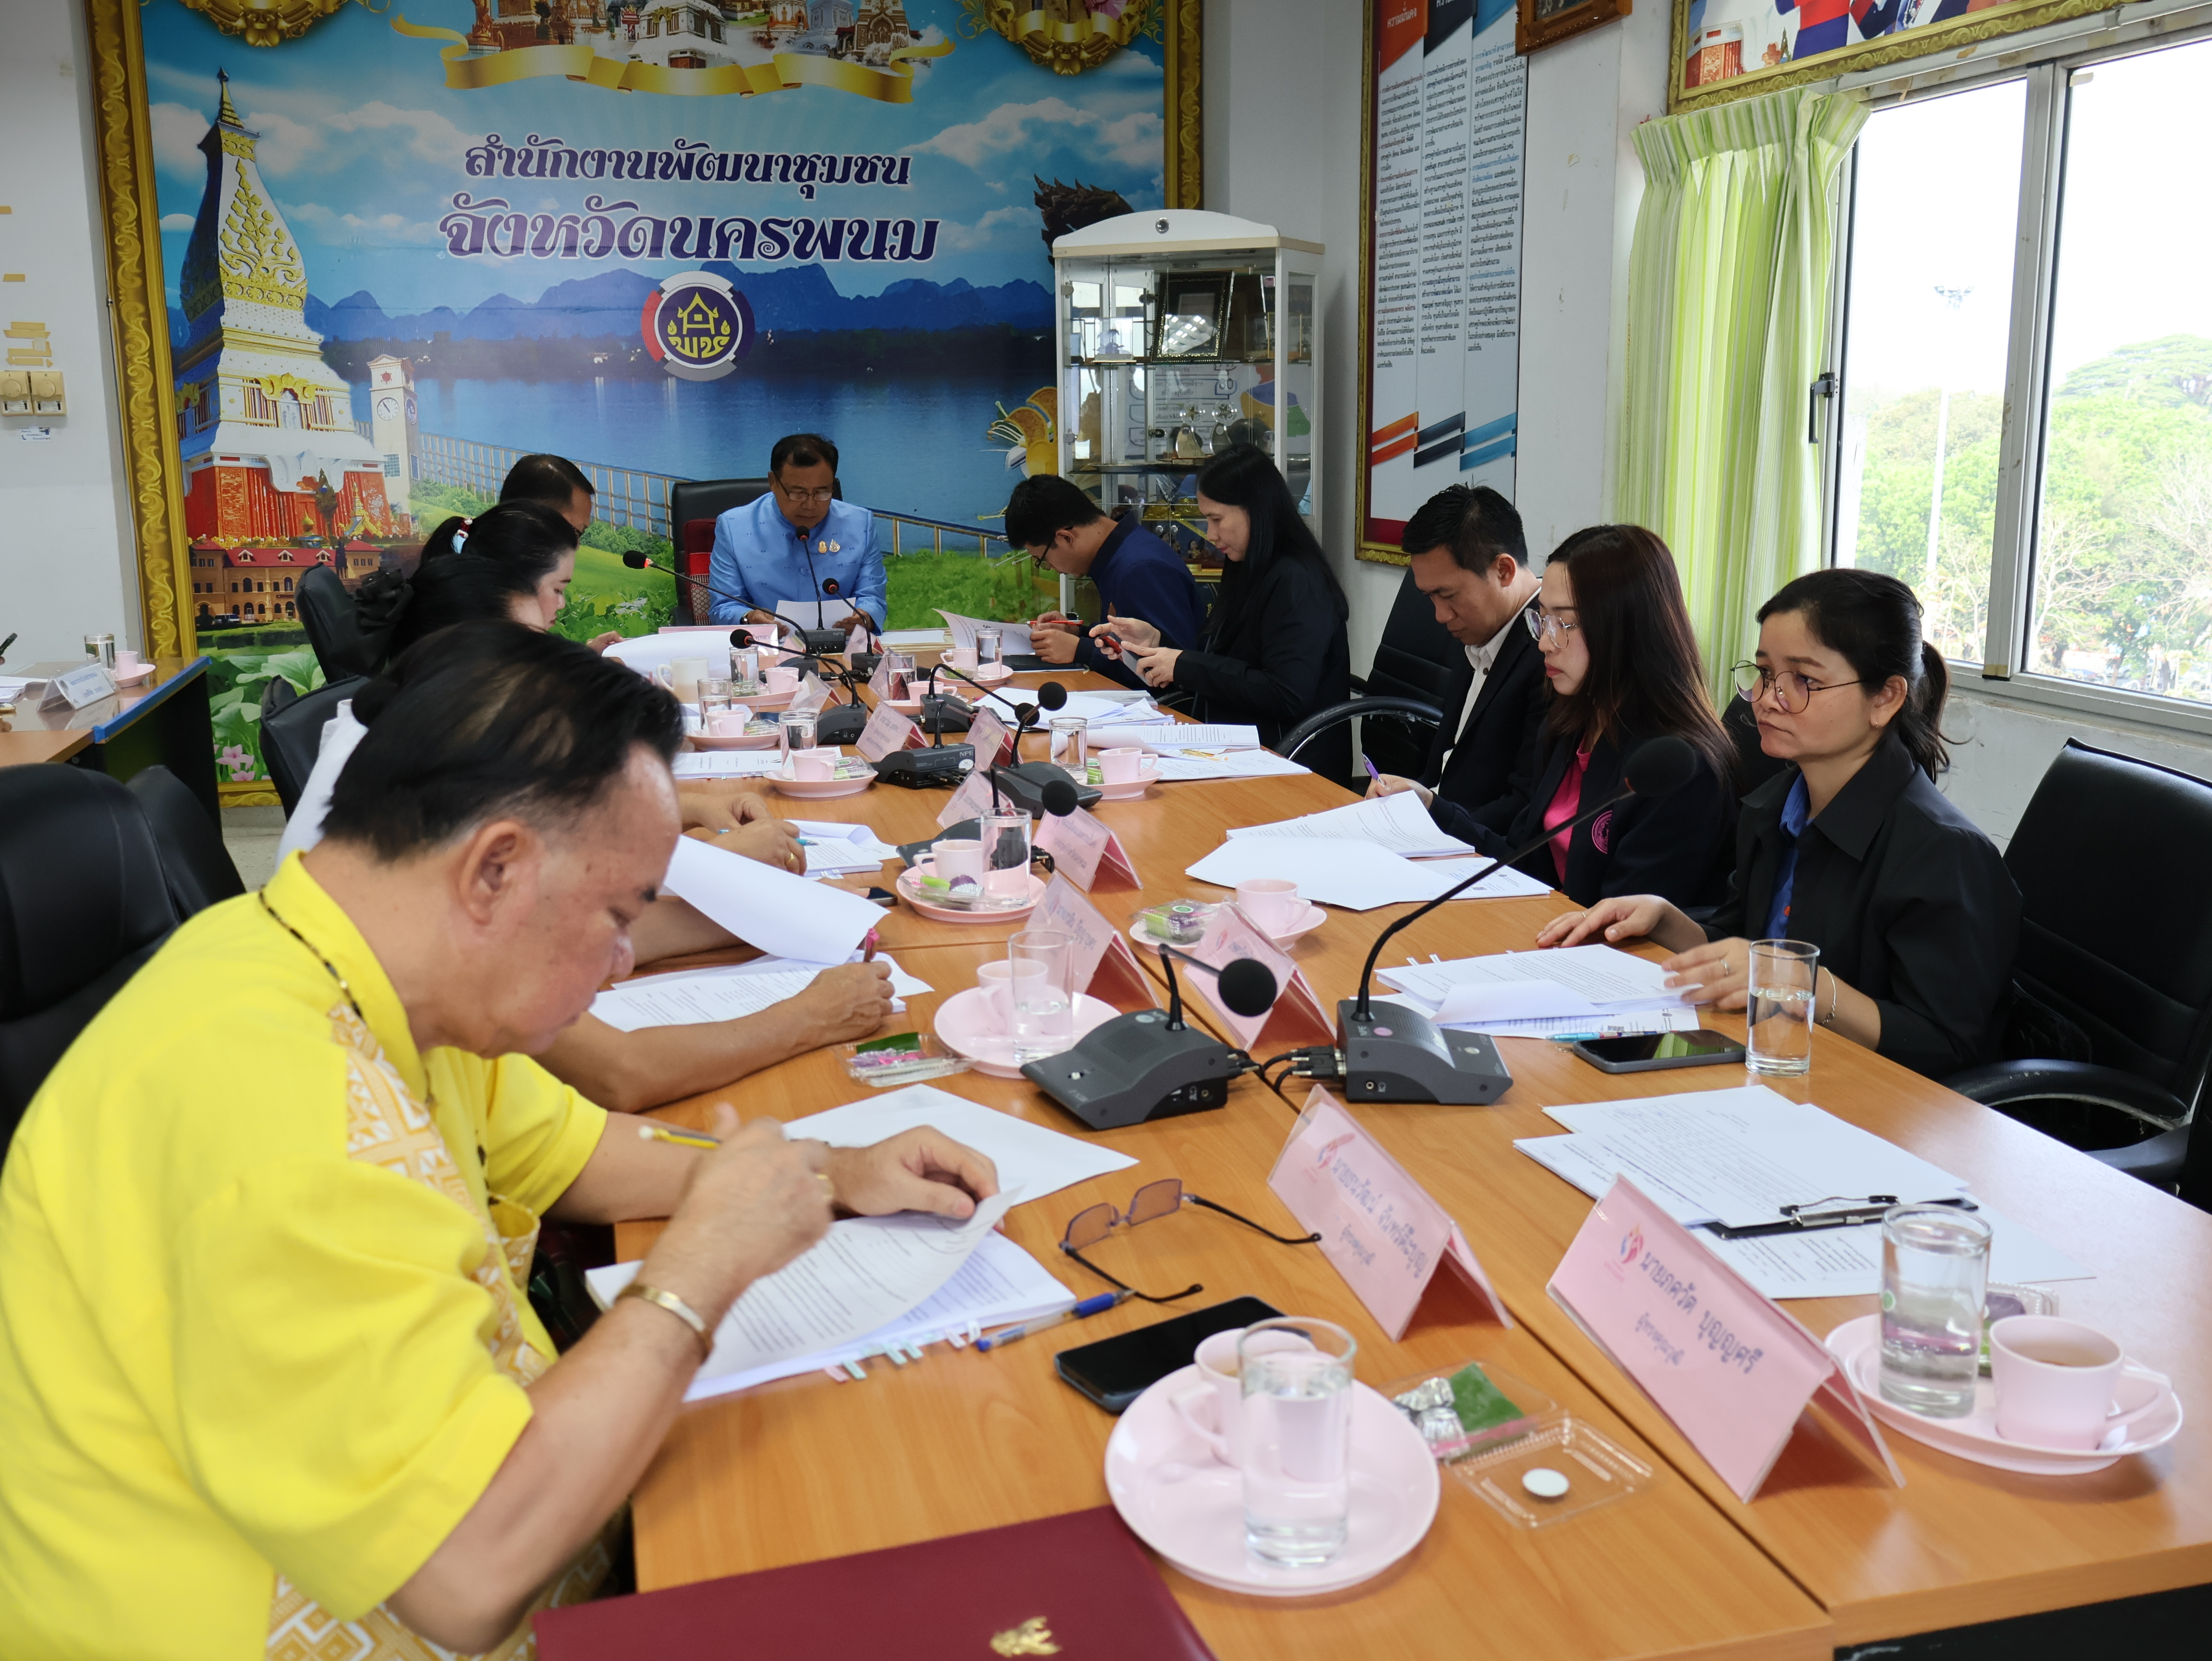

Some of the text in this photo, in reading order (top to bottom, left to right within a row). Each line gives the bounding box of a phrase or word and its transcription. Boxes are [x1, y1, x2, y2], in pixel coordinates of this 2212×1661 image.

[465, 133, 910, 200] สำนักงานพัฒนาชุมชน
[439, 192, 940, 261] จังหวัดนครพนม
